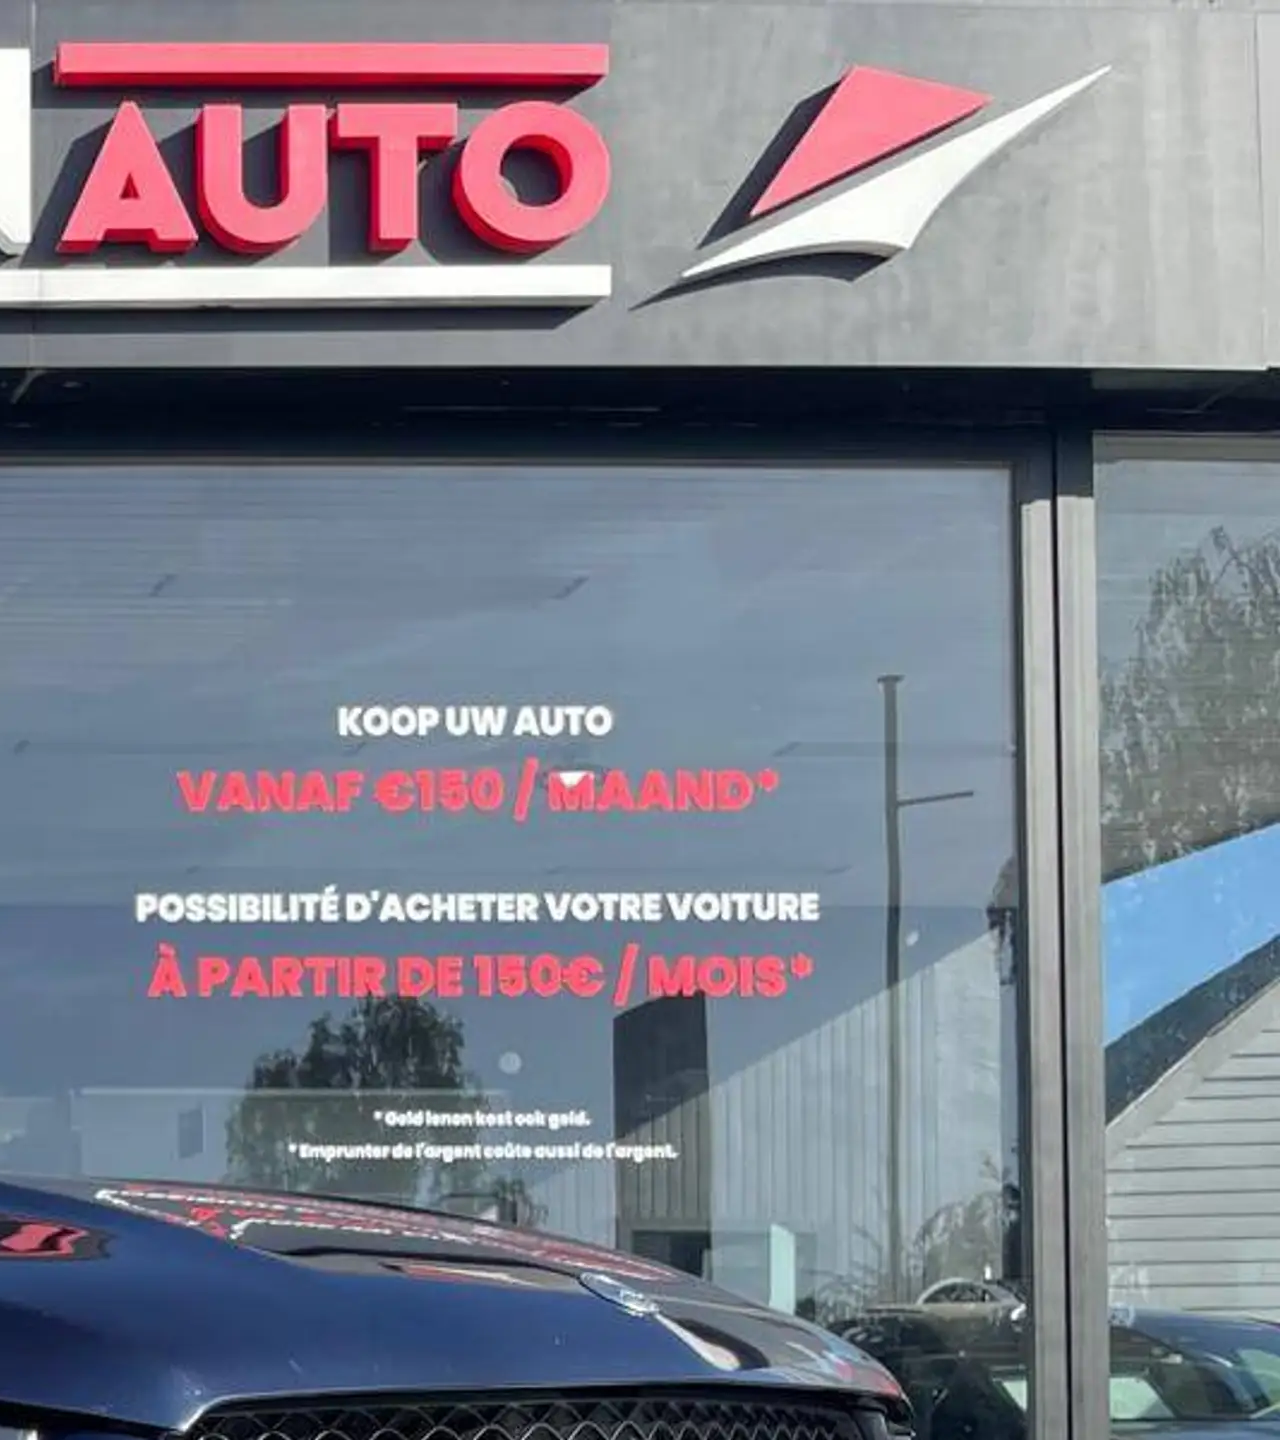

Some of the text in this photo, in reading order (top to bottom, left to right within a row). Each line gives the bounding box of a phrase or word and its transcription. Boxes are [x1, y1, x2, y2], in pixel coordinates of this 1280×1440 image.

[57, 99, 611, 255] AUTO
[338, 705, 613, 737] KOOP UW AUTO
[176, 769, 365, 812] VANAF
[373, 766, 504, 812] €150
[135, 884, 821, 922] POSSIBILITÉ D'ACHETER VOTRE VOITURE
[148, 942, 186, 997] À
[198, 954, 384, 997] PARTIR
[399, 954, 464, 997] DE
[472, 953, 605, 998] 150€
